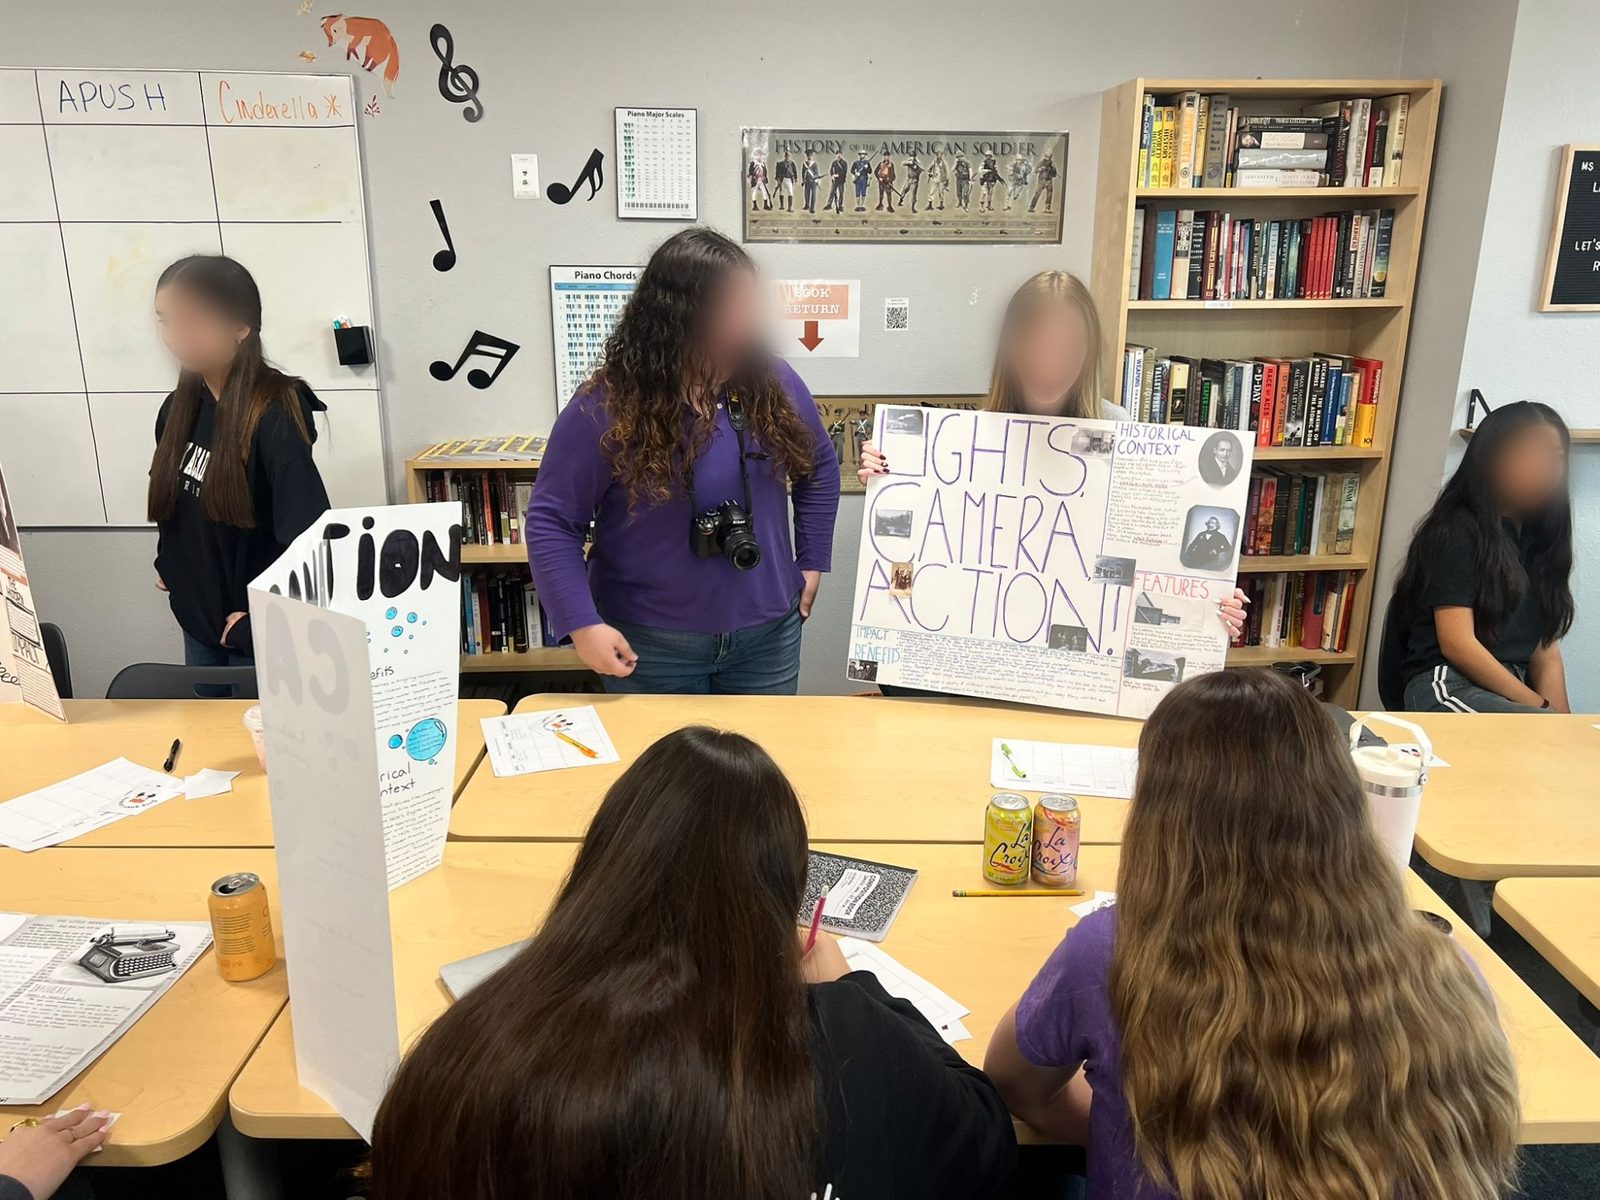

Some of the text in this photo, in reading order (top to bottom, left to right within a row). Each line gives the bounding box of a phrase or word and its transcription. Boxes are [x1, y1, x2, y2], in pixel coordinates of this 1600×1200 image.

[58, 80, 167, 113] APUSH
[218, 80, 318, 123] Cinderella
[775, 139, 846, 155] HISTORY
[879, 140, 967, 156] AMERICAN
[972, 142, 1037, 156] SOLDIER
[1581, 162, 1594, 171] MS
[574, 271, 637, 280] Piano Chords
[784, 304, 840, 314] RETURN
[1308, 407, 1316, 428] ATOMIC
[1120, 423, 1196, 442] HISTORICAL
[1117, 440, 1181, 456] CONTEXT
[868, 481, 1091, 582] CAMERA,
[1132, 572, 1210, 600] FEATURES
[854, 626, 889, 641] IMPACT
[854, 644, 900, 664] BENEFITS
[1011, 823, 1030, 849] La
[1044, 826, 1066, 852] La
